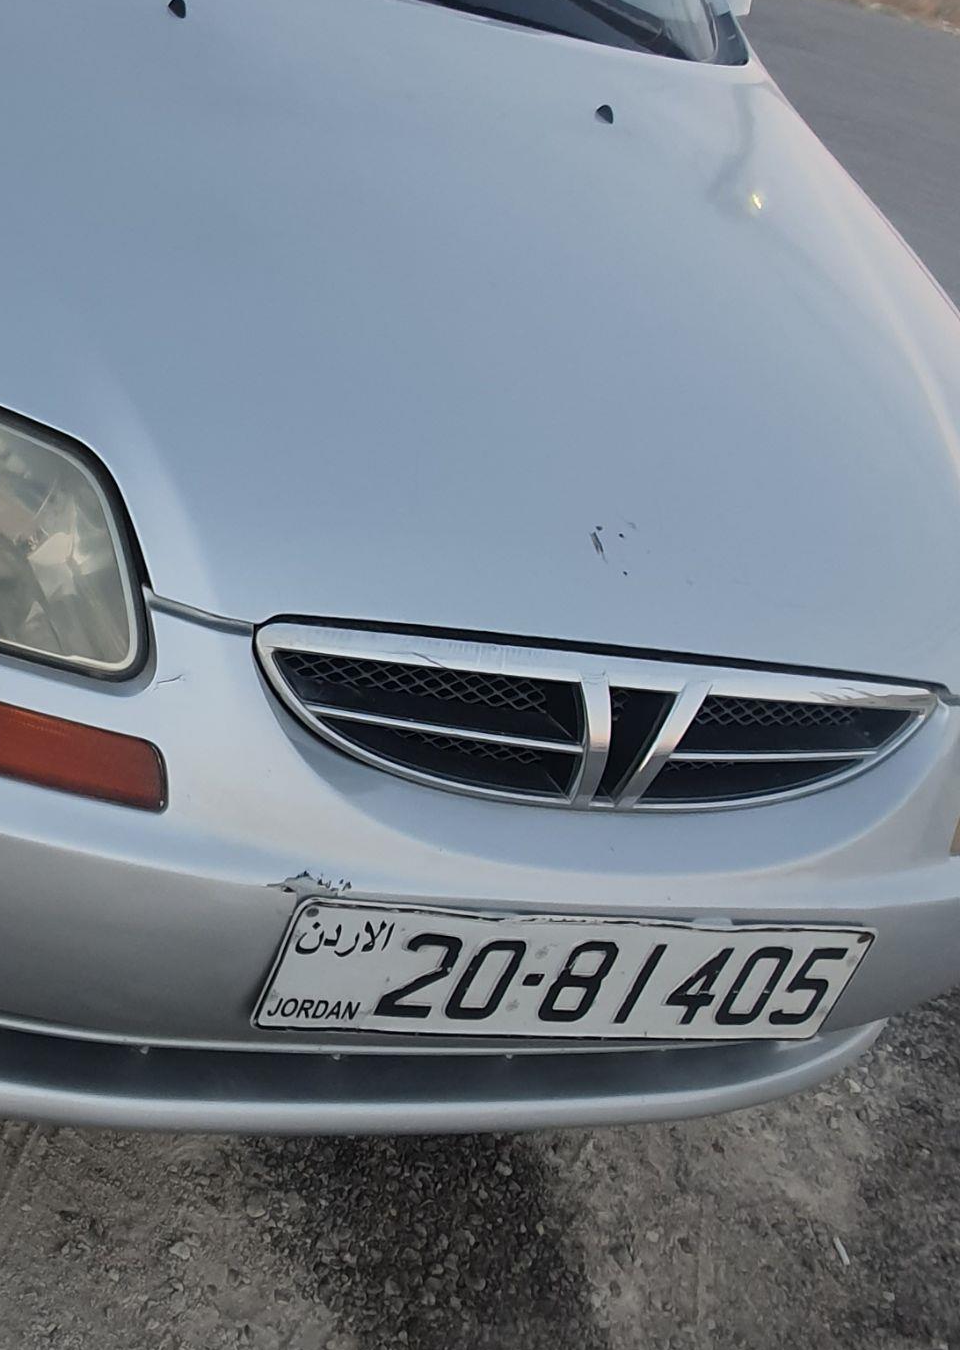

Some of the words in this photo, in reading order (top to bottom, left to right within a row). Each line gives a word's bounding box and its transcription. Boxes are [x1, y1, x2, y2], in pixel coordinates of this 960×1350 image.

[294, 920, 396, 958] الاردن
[372, 932, 849, 1026] 20-81405
[266, 997, 362, 1021] JORDAN
